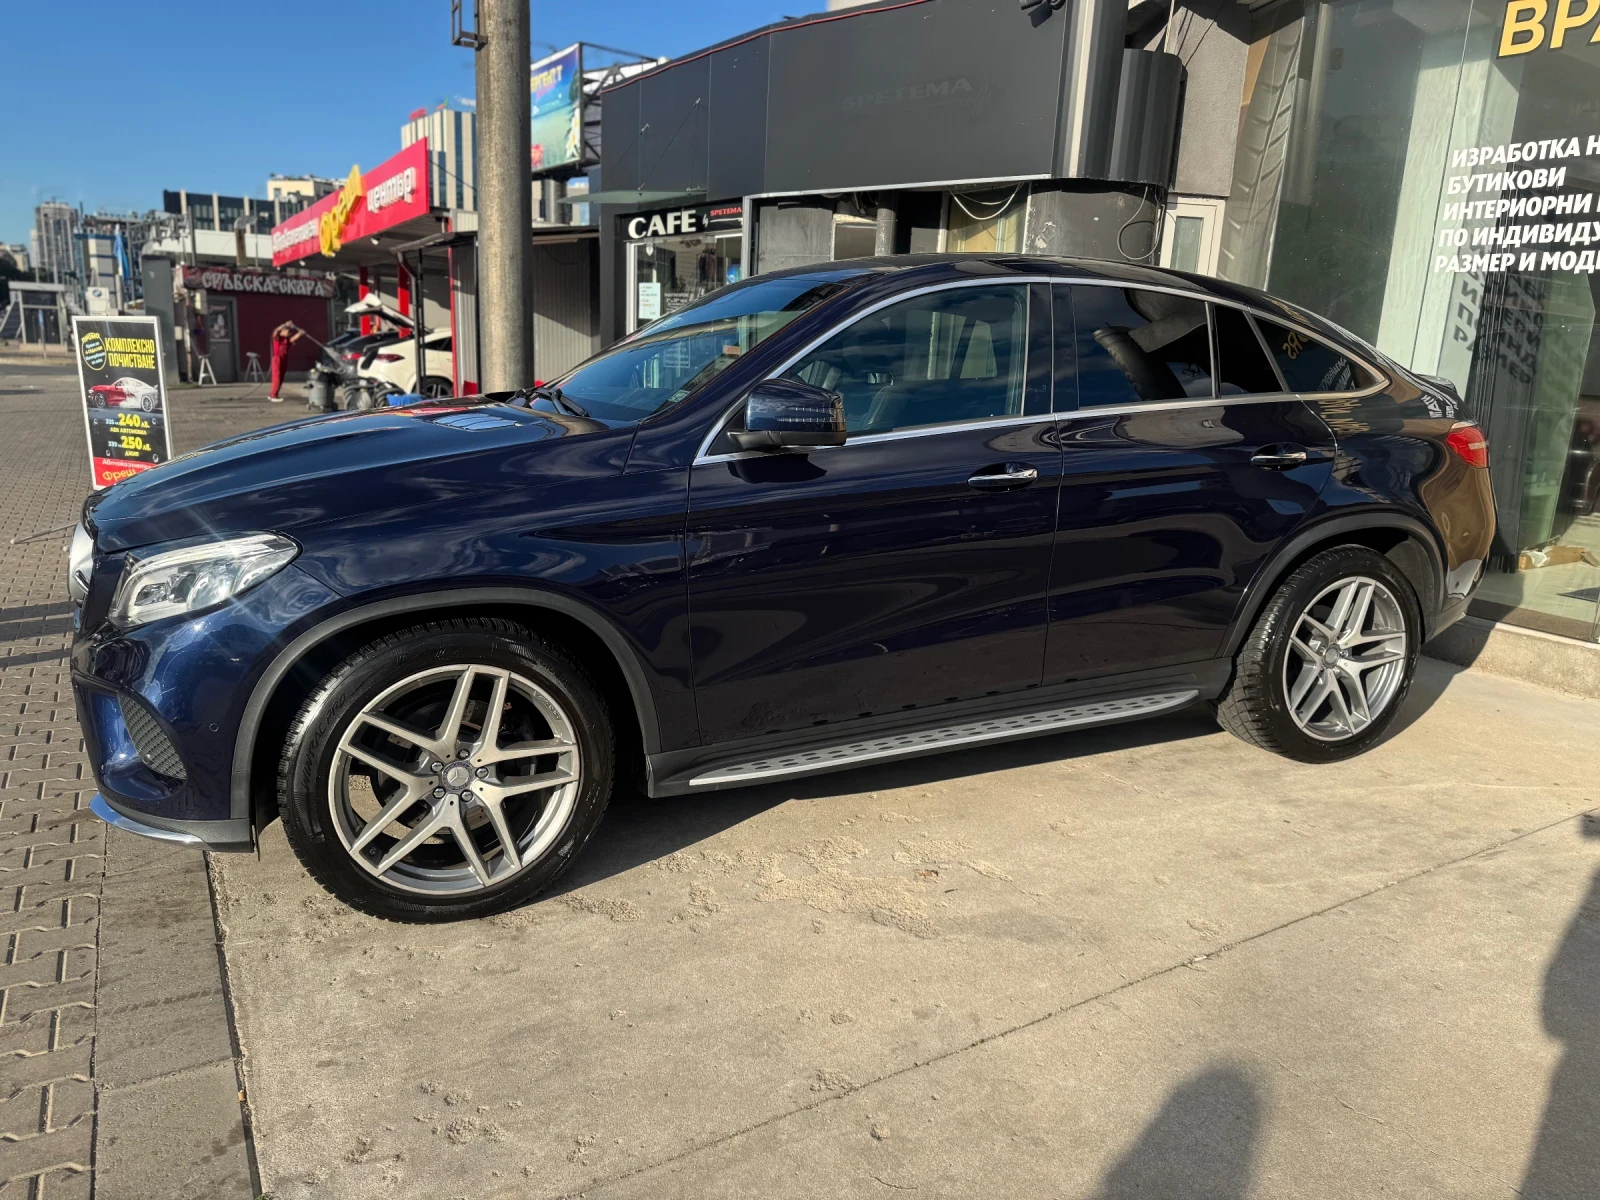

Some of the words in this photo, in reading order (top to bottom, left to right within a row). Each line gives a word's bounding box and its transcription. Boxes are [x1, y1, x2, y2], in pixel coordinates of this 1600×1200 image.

[1498, 0, 1600, 57] ВР
[1451, 137, 1581, 168] ИЗРАБОТКА
[366, 166, 417, 214] център
[1447, 166, 1567, 195] БУТИКОВИ
[1442, 193, 1593, 221] ИНТЕРИОРНИ
[628, 209, 697, 239] CAFE
[710, 207, 742, 217] SPETEMA
[1438, 228, 1469, 247] ПО
[1433, 252, 1516, 273] РАЗМЕР
[1518, 251, 1537, 271] И
[202, 271, 274, 293] СРЪБСКА
[278, 277, 325, 297] СКАРА
[104, 337, 155, 354] КОМПЛЕКСНО
[108, 352, 156, 369] ПОЧИСТВАНЕ
[118, 413, 141, 428] 240
[120, 435, 143, 450] 250
